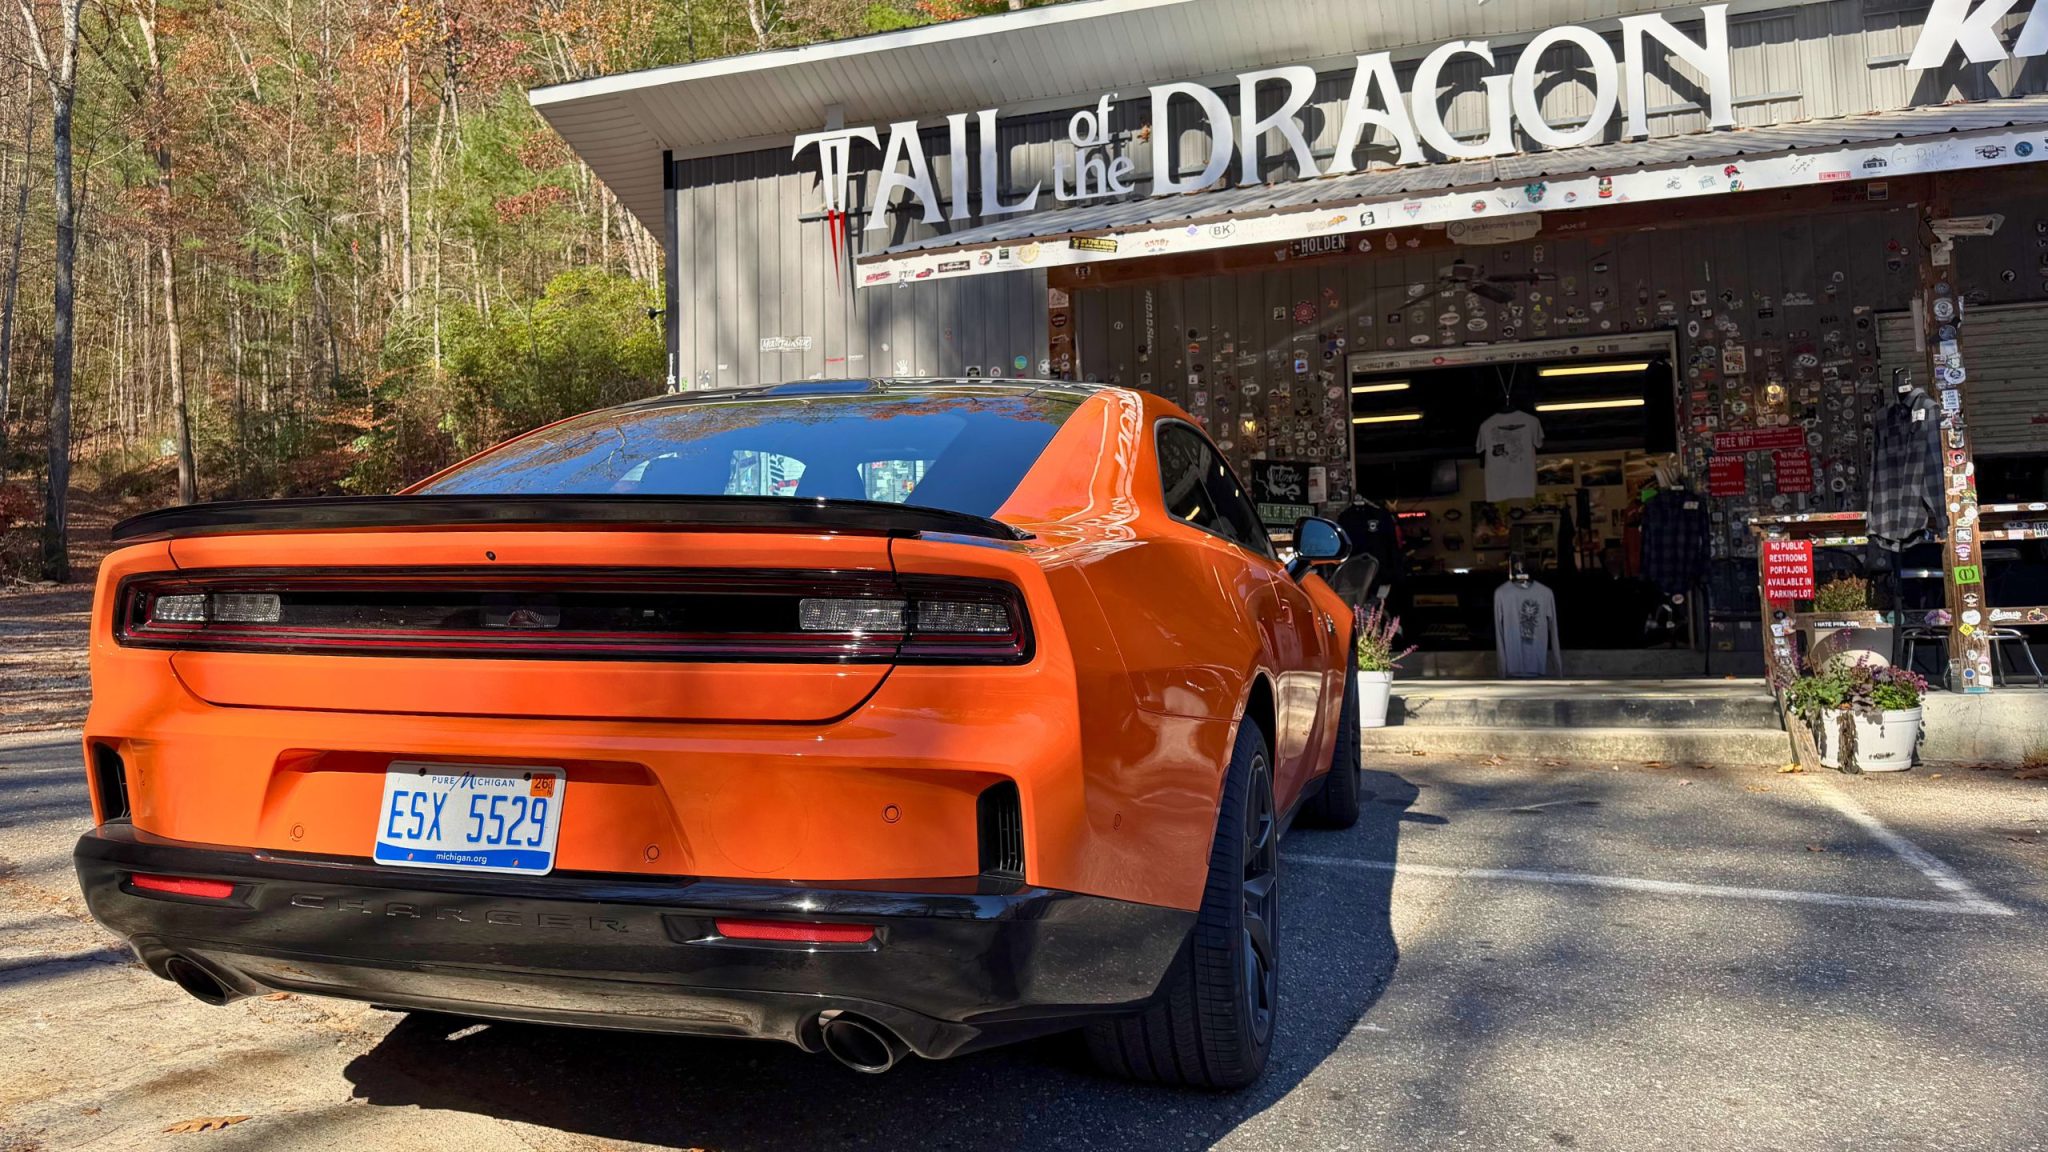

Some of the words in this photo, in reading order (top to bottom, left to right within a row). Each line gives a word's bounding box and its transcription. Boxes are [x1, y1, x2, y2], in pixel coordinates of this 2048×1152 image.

[1906, 0, 2048, 70] K
[1149, 3, 1738, 197] DRAGON
[1067, 92, 1118, 149] of
[791, 108, 1042, 231] TAIL
[1052, 147, 1135, 201] the
[1213, 225, 1231, 236] BK
[1301, 234, 1346, 254] HOLDEN
[1716, 437, 1736, 448] FREE
[1738, 435, 1754, 447] WIFI
[1708, 455, 1744, 464] DRINKS
[1771, 542, 1780, 550] NO
[1781, 541, 1804, 550] PUBLIC
[1769, 553, 1808, 562] RESTROOMS
[1767, 577, 1804, 586] AVAILABLE
[1805, 577, 1812, 585] IN
[1770, 589, 1798, 598] PARKING
[1799, 589, 1812, 598] LOT
[431, 776, 455, 785] PURE
[451, 771, 516, 790] MICHIGAN
[534, 777, 548, 789] 26
[387, 790, 448, 841] ESX
[466, 794, 548, 847] 5529
[435, 852, 488, 865] michigan.org
[291, 893, 630, 934] CHARGER
